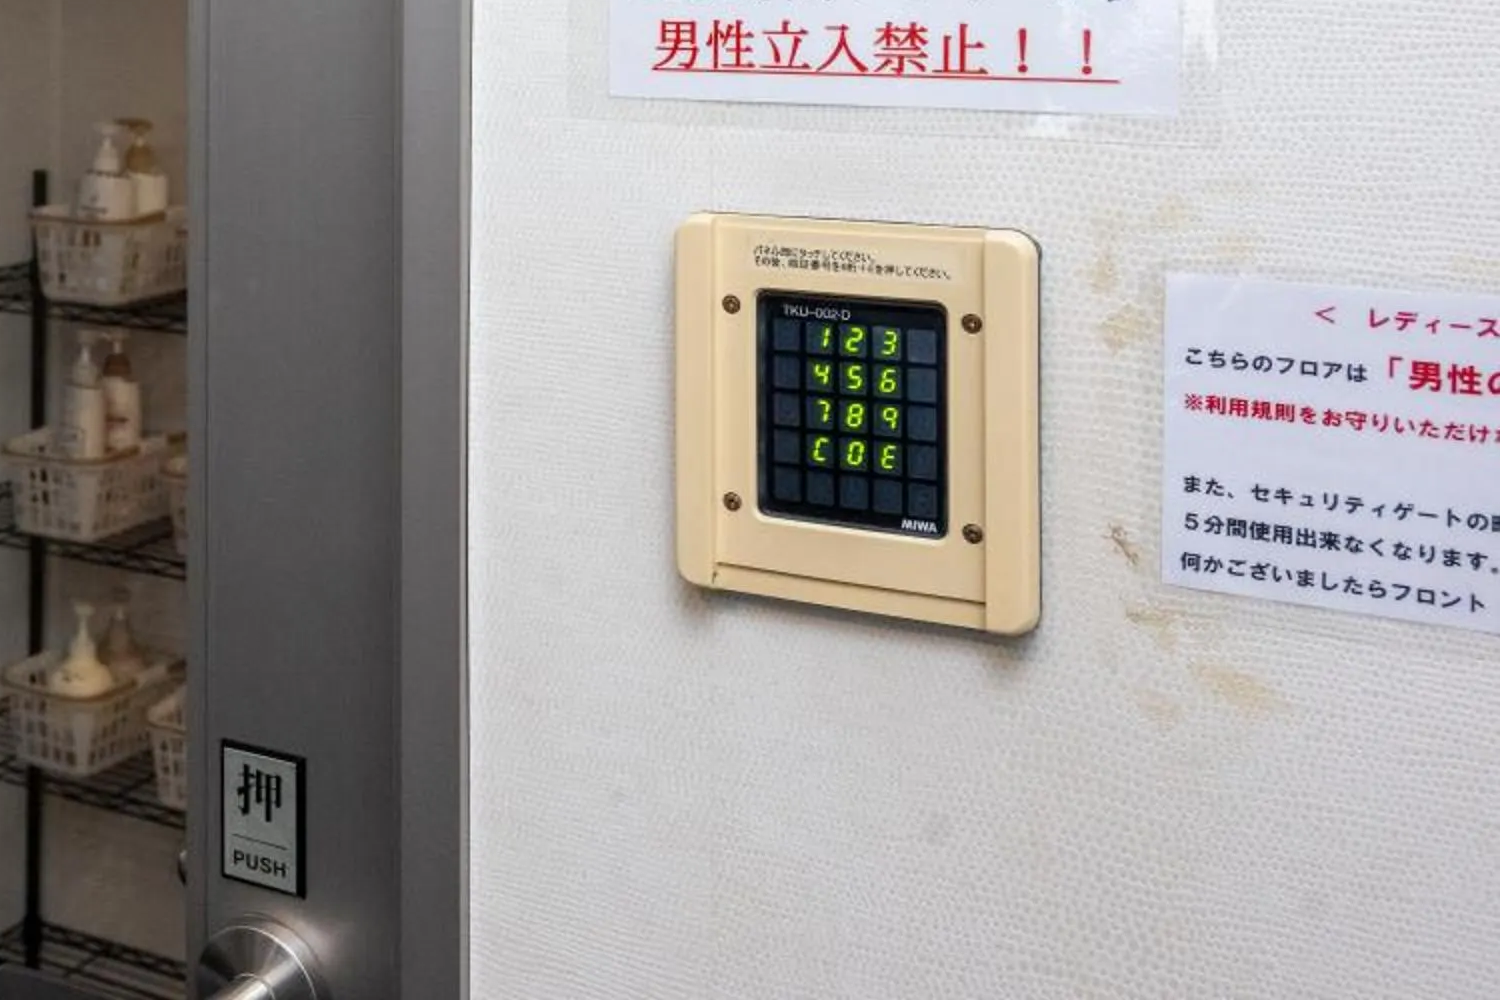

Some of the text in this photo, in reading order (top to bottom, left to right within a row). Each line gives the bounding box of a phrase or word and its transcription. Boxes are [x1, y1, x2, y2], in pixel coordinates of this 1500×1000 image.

[654, 19, 1097, 76] 男性立入禁止！！
[820, 327, 898, 356] 1 2 3
[813, 363, 898, 394] 4 5 6
[818, 399, 899, 431] 7 8 9
[1183, 393, 1500, 445] ※利用規則をお守りいただけ
[812, 437, 830, 463] C
[880, 444, 899, 471] E
[901, 519, 938, 534] MIWA
[1180, 551, 1487, 614] 何かございましたらフロント
[236, 763, 283, 823] 押
[232, 850, 288, 879] PUSH
